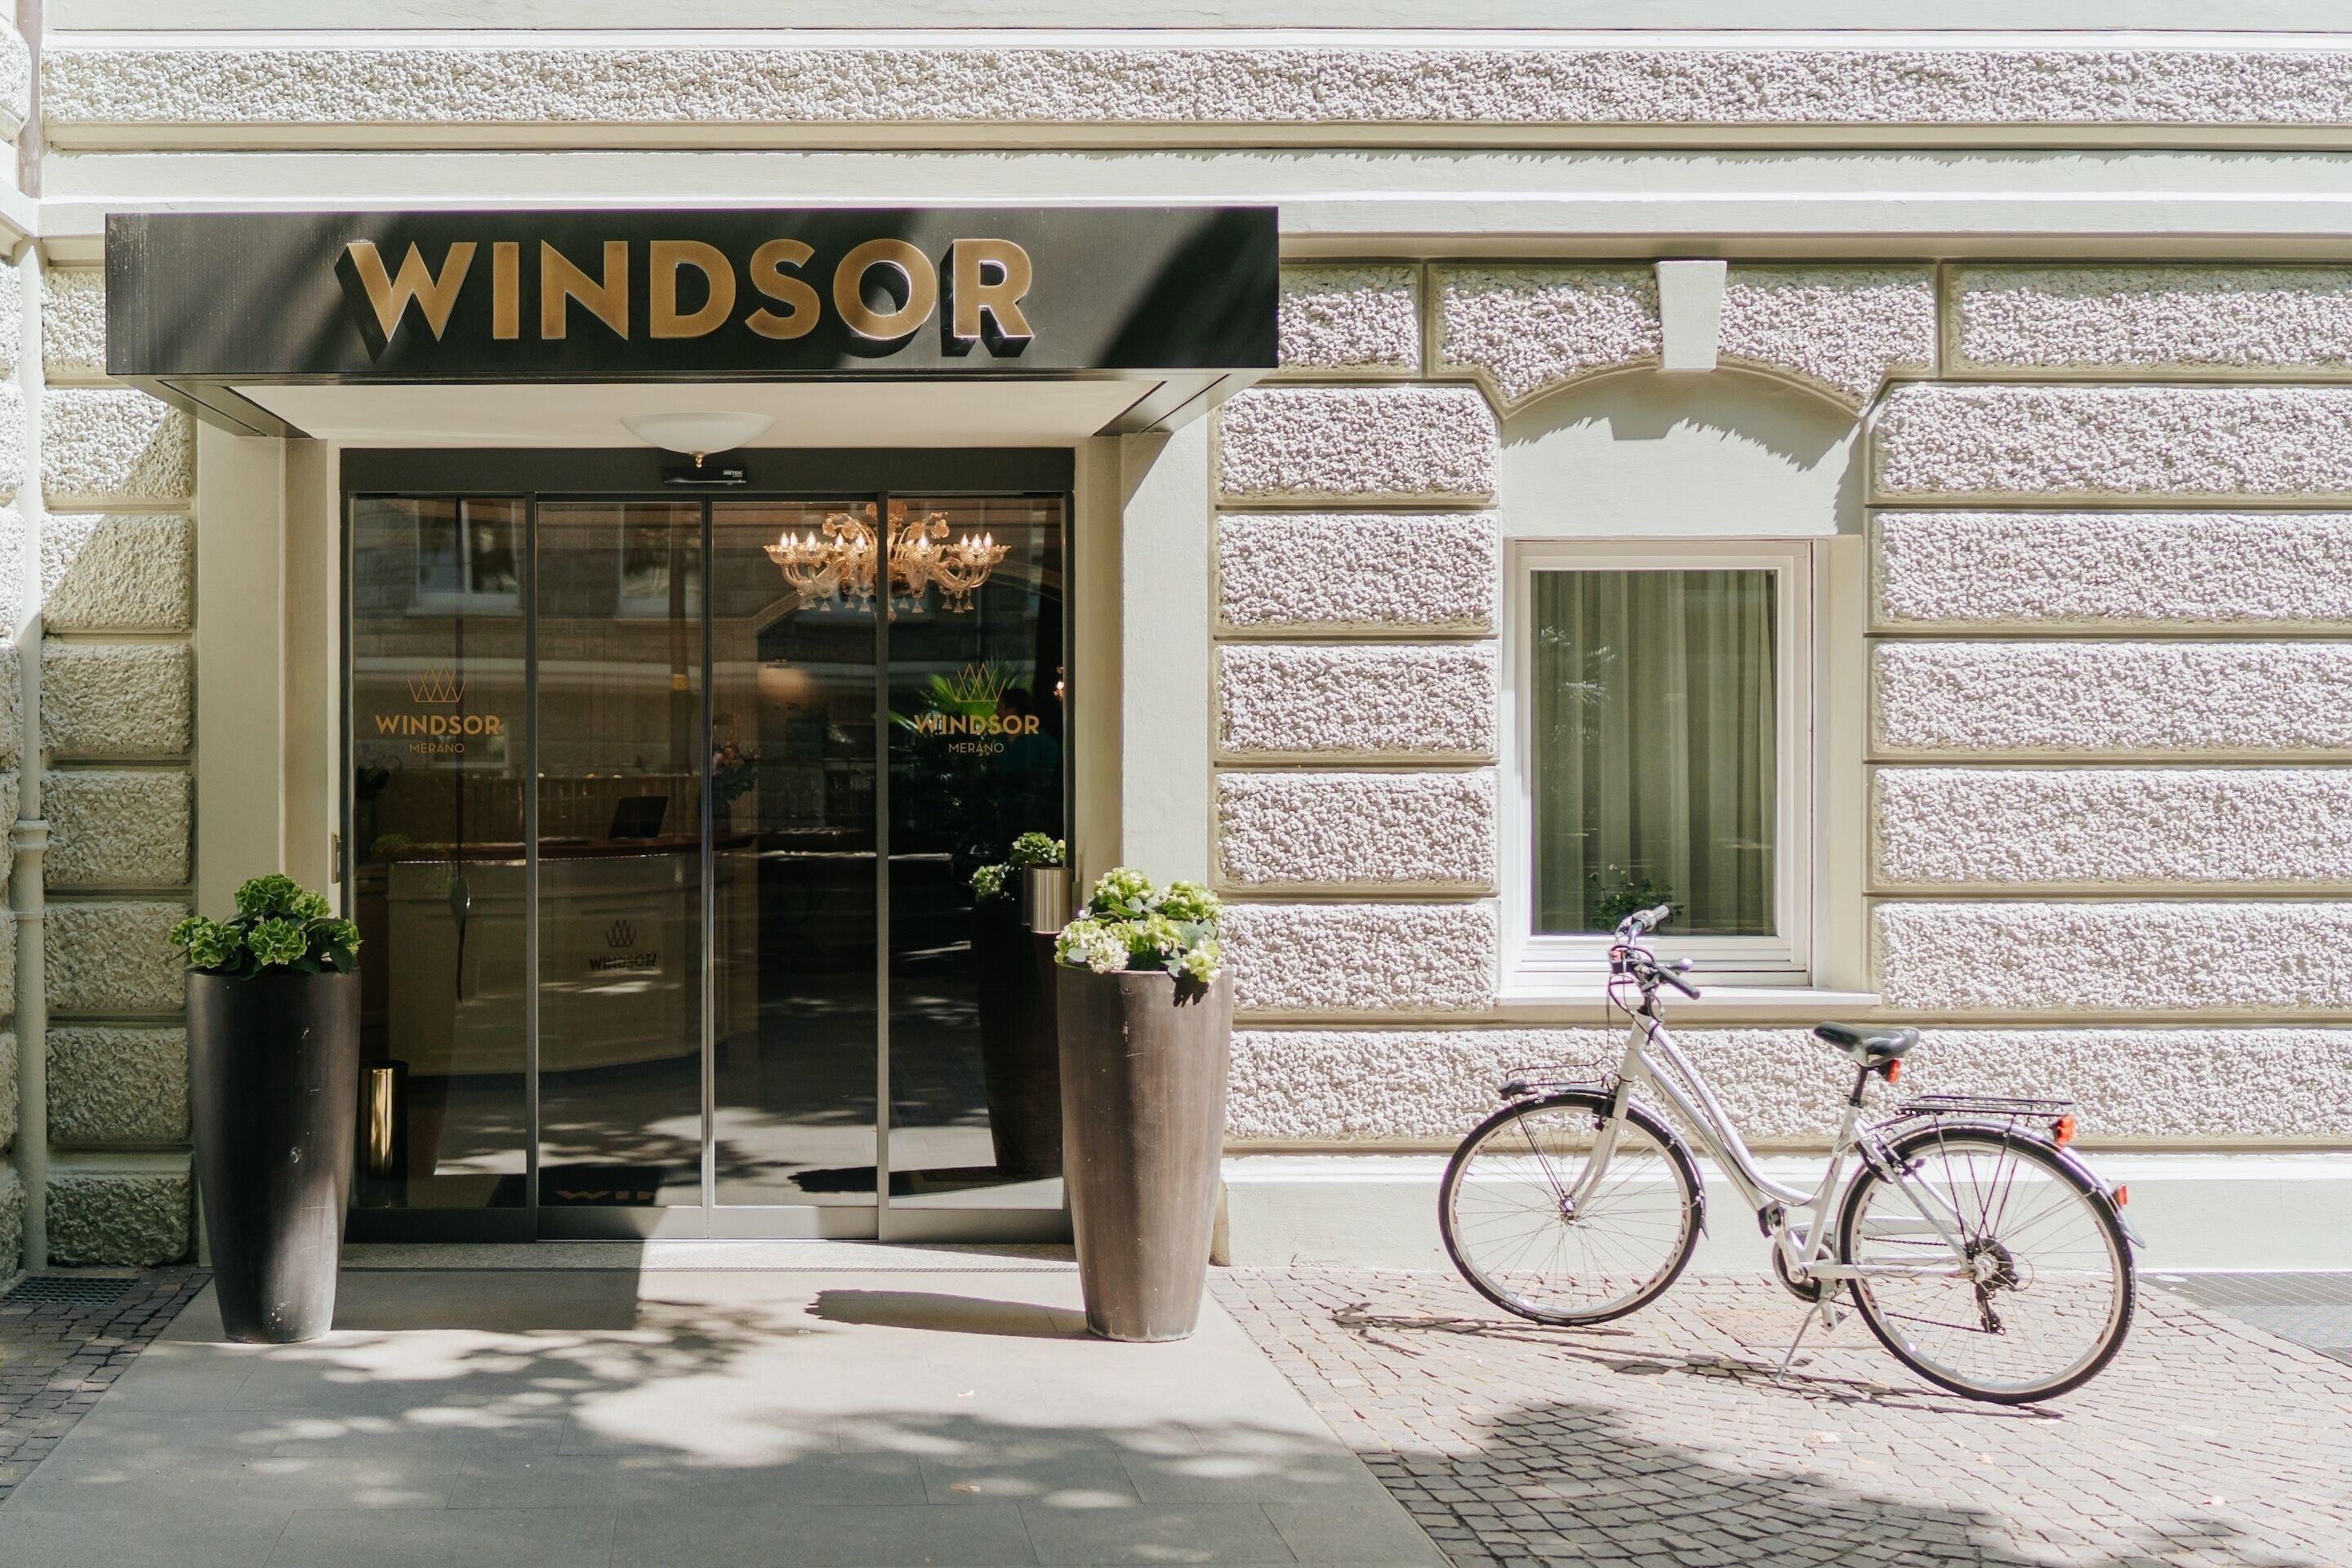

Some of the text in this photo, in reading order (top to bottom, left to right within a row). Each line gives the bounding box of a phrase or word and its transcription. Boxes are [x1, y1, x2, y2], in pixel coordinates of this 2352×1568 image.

[346, 238, 1034, 343] WINDSOR
[374, 715, 501, 736] WINDSOR
[913, 715, 1040, 736] WINDSOR
[408, 742, 466, 754] MERANO
[948, 742, 1004, 754] MERANO
